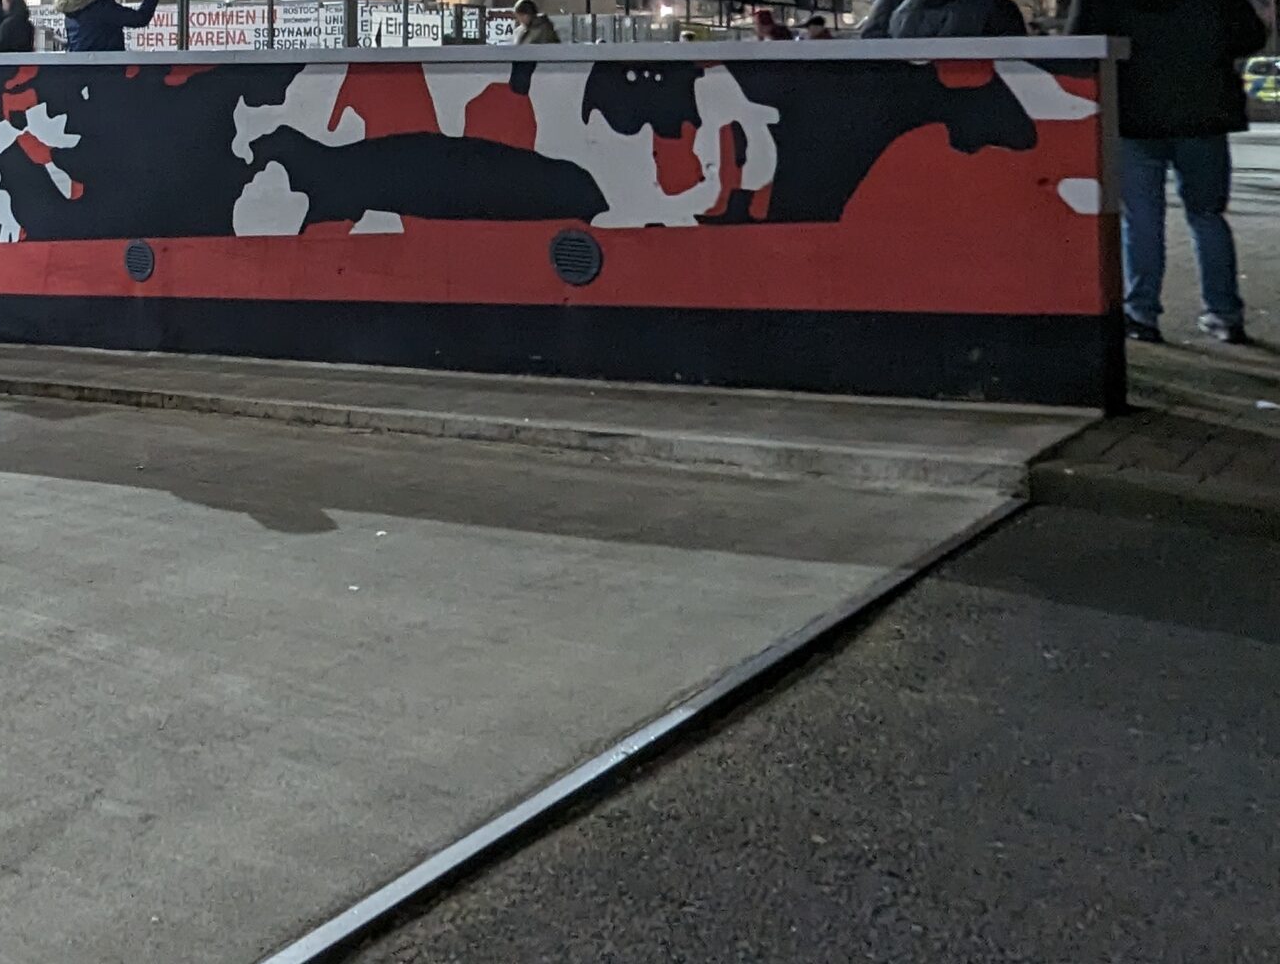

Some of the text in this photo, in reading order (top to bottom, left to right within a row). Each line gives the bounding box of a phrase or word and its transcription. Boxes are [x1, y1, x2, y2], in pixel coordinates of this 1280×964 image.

[154, 9, 256, 27] WILKOMMEN
[386, 17, 439, 41] Eingang
[136, 33, 165, 48] DER
[169, 29, 251, 47] BYARENA.
[254, 38, 308, 50] DRSDEN
